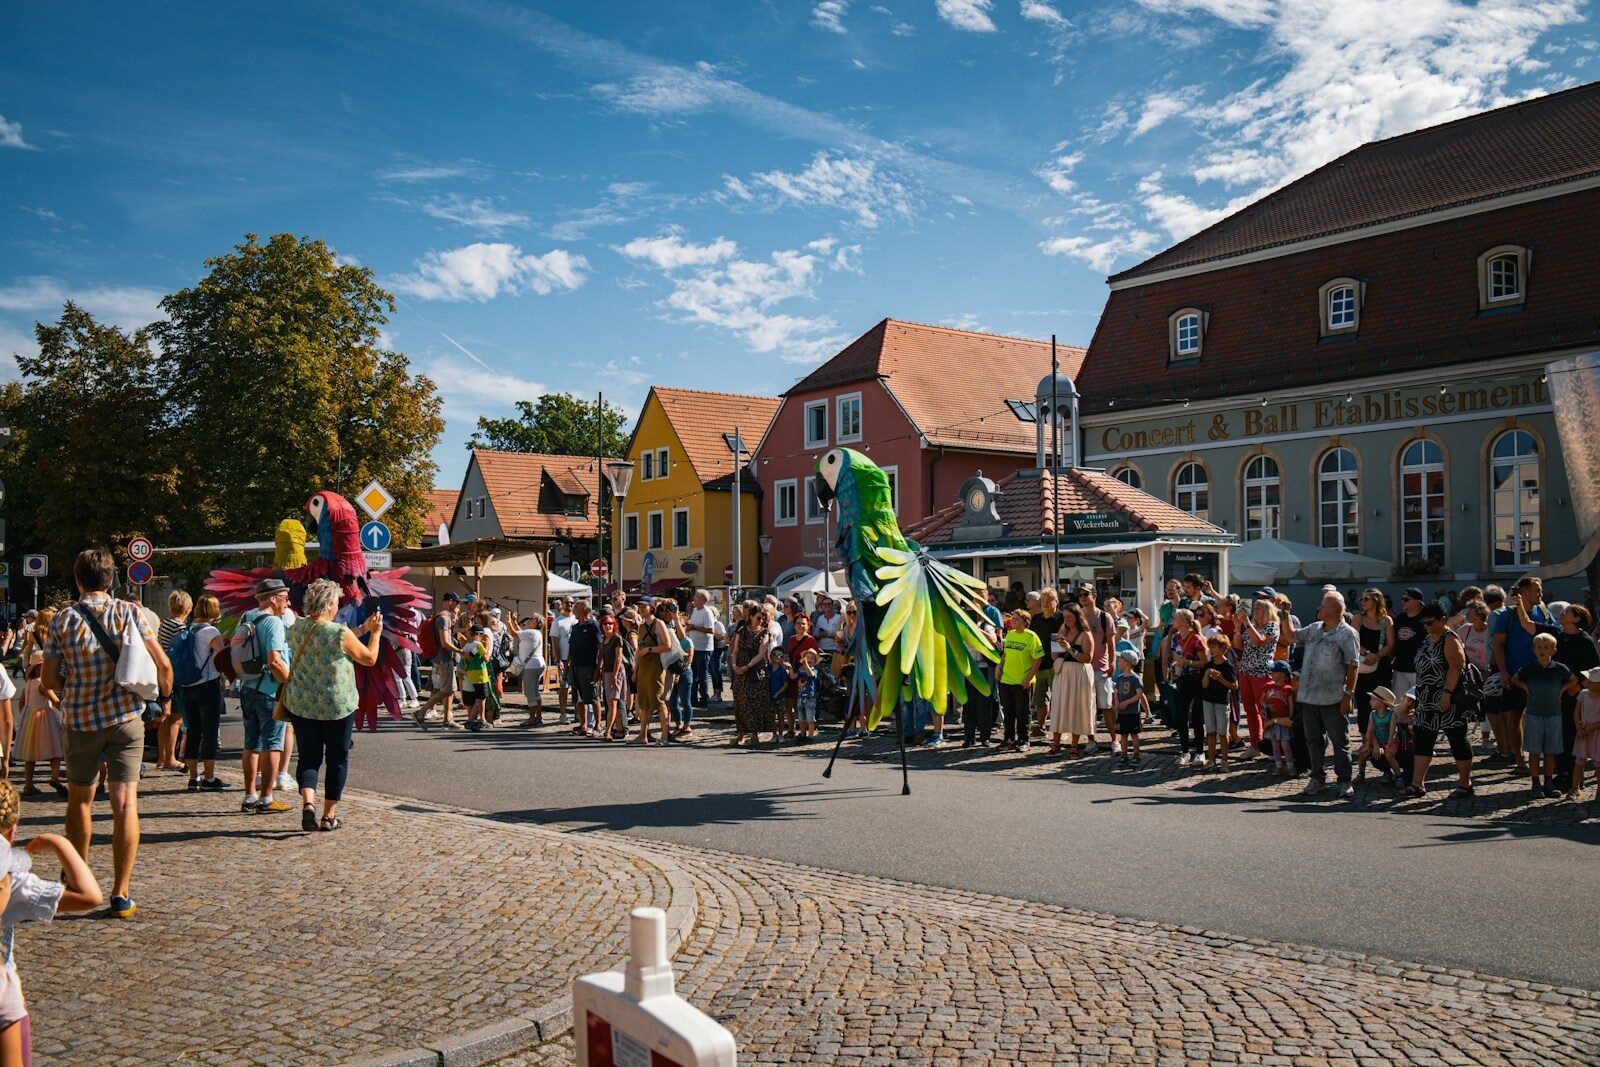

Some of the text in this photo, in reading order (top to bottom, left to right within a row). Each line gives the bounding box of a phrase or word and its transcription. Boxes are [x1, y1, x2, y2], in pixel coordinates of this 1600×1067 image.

[1102, 379, 1548, 452] Concert & Ball Etablissement
[1073, 519, 1120, 530] Wackerbarth
[134, 544, 147, 555] 30
[1122, 682, 1130, 694] 9
